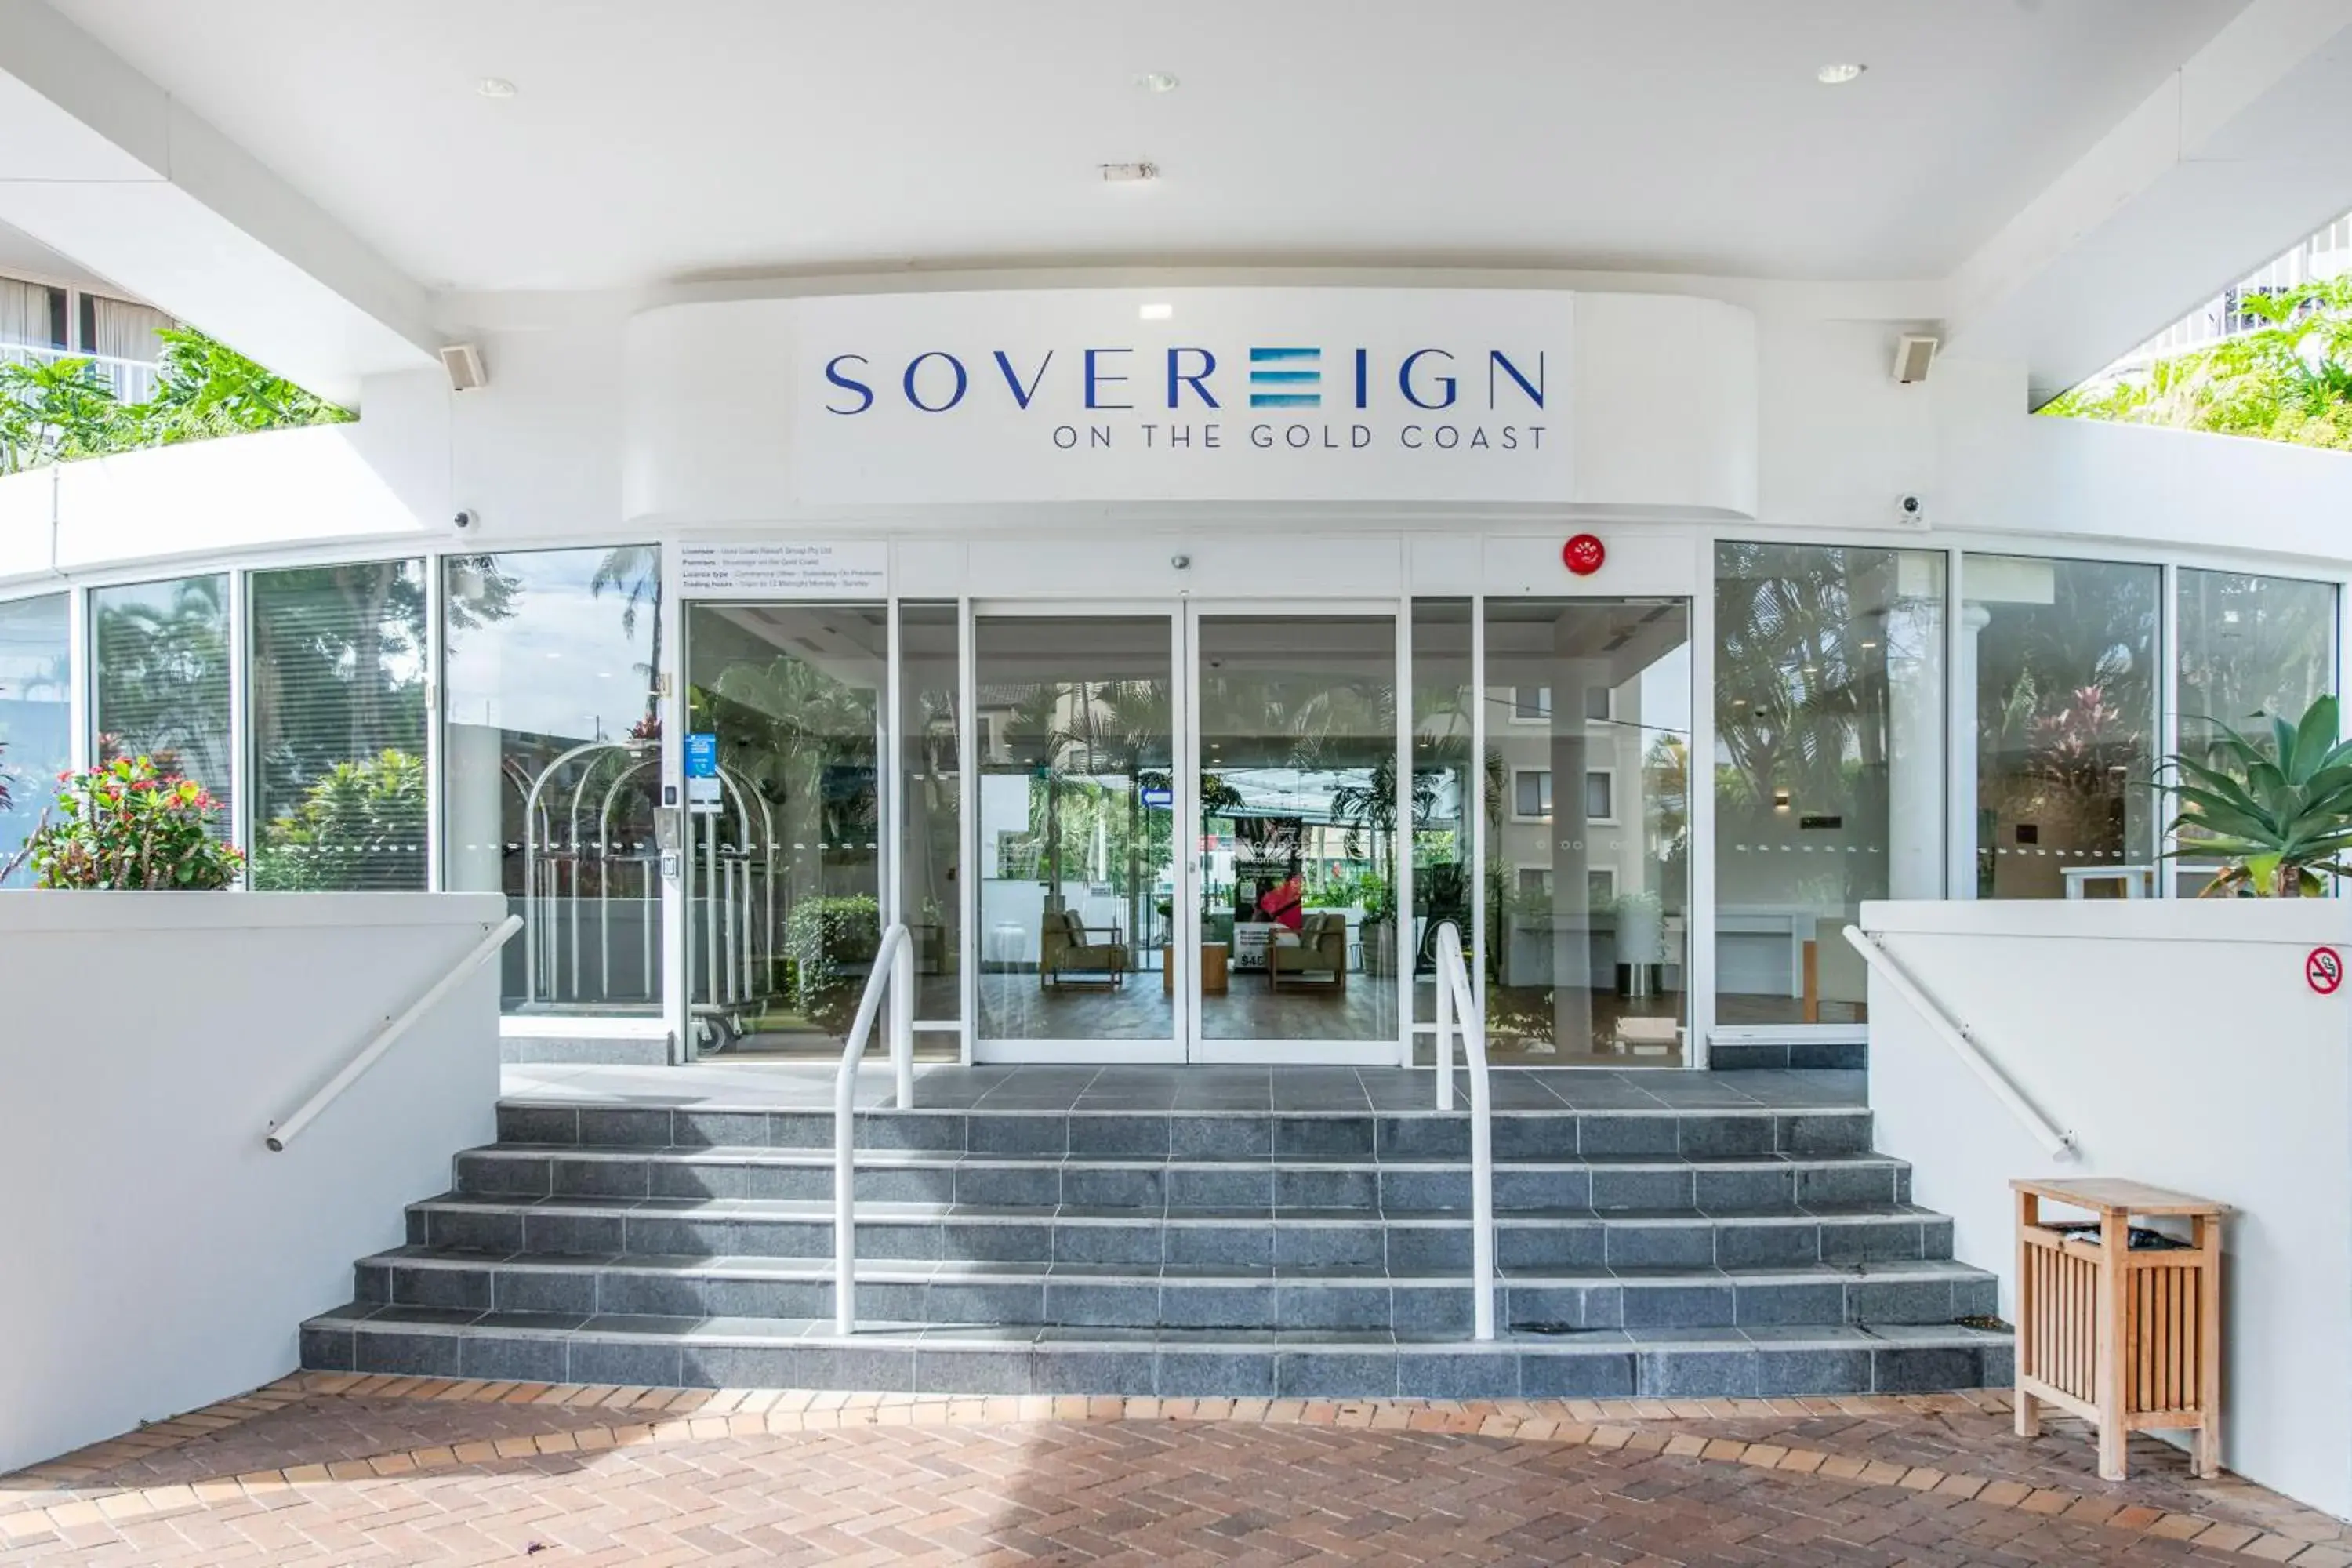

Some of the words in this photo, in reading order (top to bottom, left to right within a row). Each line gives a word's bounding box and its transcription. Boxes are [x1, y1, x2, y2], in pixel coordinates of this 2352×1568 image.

[825, 347, 1544, 414] SOVEREIGN
[1053, 425, 1110, 448] ON
[1141, 424, 1221, 448] THE
[1250, 424, 1371, 448] GOLD
[1400, 425, 1546, 449] COAST
